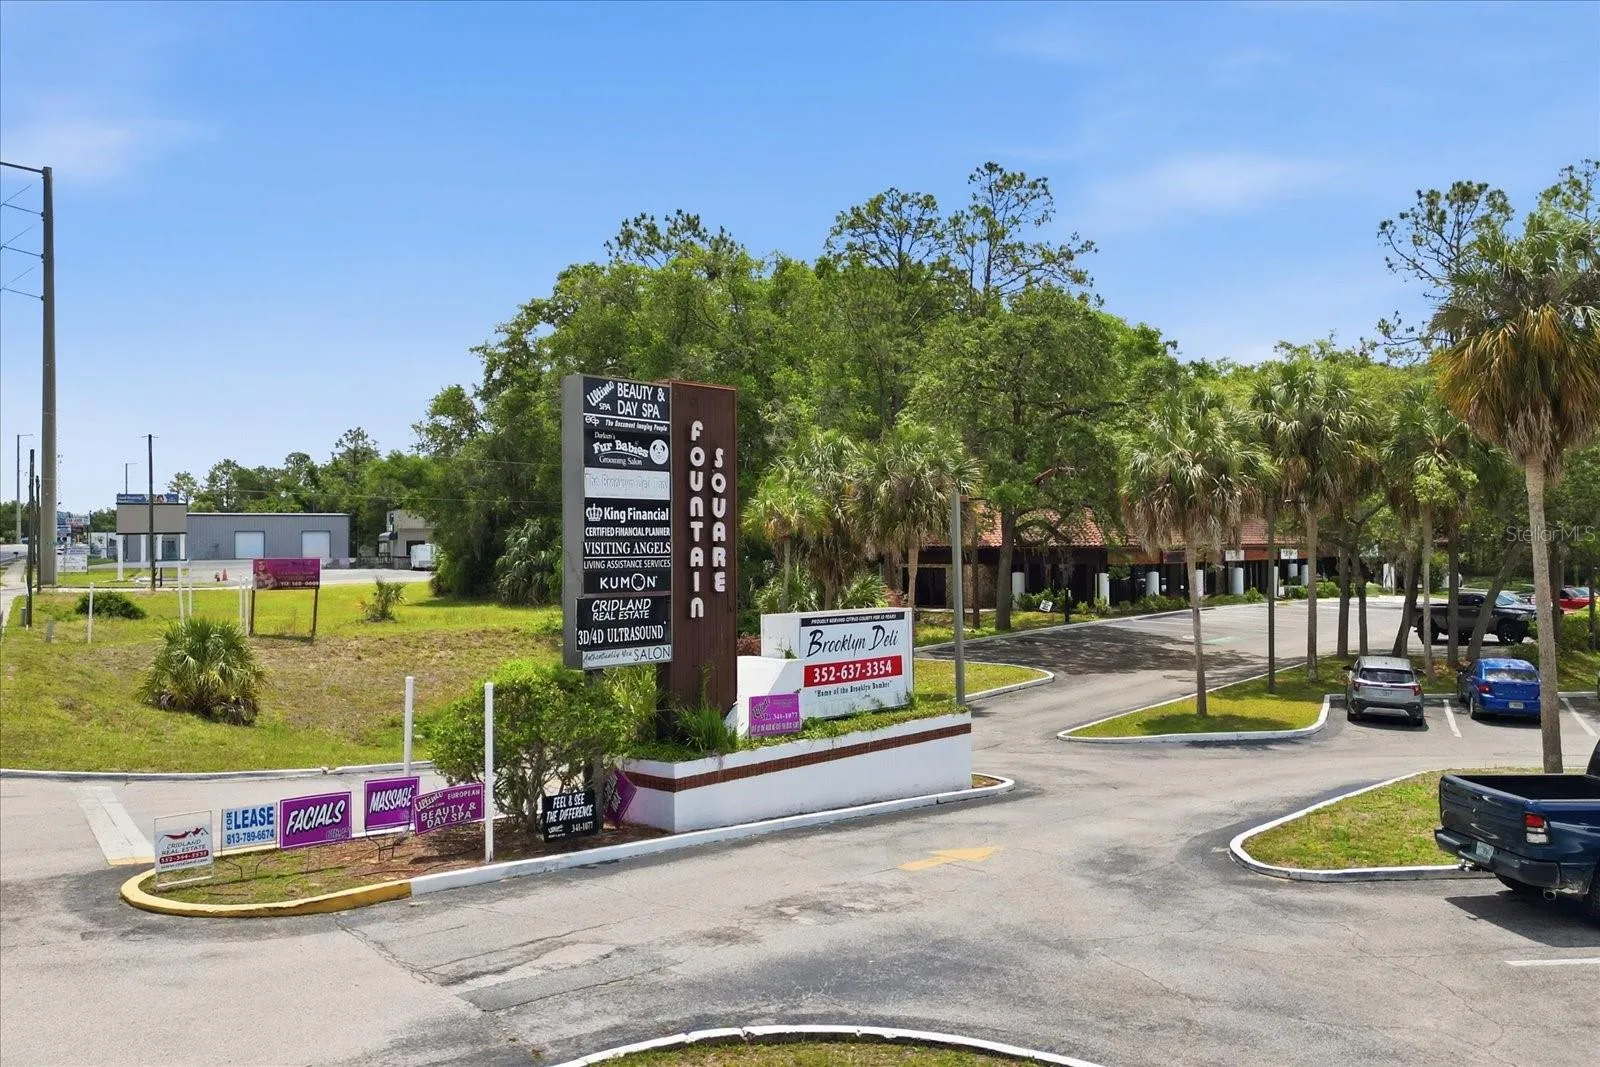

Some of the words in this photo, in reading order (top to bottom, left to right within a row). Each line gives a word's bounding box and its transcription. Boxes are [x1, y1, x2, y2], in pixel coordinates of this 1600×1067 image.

[617, 382, 653, 401] BEAUTY
[657, 387, 666, 402] &
[599, 402, 611, 411] SPA
[617, 400, 638, 416] DAY
[642, 402, 660, 418] SPA
[605, 419, 614, 427] The
[614, 420, 635, 429] Document
[636, 422, 652, 431] Imaging
[653, 424, 668, 432] People
[592, 442, 612, 454] Fur
[615, 440, 649, 457] Babies
[599, 455, 626, 467] Grooming
[627, 457, 642, 466] Salon
[603, 506, 626, 523] King
[627, 507, 669, 521] Financial
[689, 420, 705, 618] FOUNTAIN
[711, 447, 727, 592] SQUARE
[585, 527, 615, 537] CERTIFIED
[615, 527, 644, 537] FINANCIAL
[645, 527, 670, 536] PLANNER
[584, 541, 631, 555] VISITING
[632, 541, 671, 554] ANGELS
[584, 560, 606, 569] LIVING
[606, 560, 642, 569] ASSISTANCE
[644, 559, 671, 568] SERVICES
[600, 573, 656, 591] KUMON
[591, 598, 652, 613] CRIDLAND
[592, 611, 616, 622] REAL
[618, 609, 650, 620] ESTATE
[811, 617, 829, 625] PROUDLY
[829, 616, 845, 624] SERVING
[859, 614, 873, 622] COUNTY
[578, 628, 604, 646] 3D/4D
[607, 624, 664, 643] ULTRASOUND
[806, 629, 866, 657] Brooklyn
[868, 625, 899, 651] Deli
[633, 646, 671, 662] SALON
[813, 660, 892, 683] 352-637-3354
[840, 686, 848, 694] the
[850, 683, 871, 693] Brooklyn
[370, 785, 414, 814] MASSAGE
[447, 789, 480, 800] EUROPEAN
[553, 794, 566, 809] FEEL
[574, 792, 585, 806] SEE
[233, 806, 274, 830] LEASE
[286, 799, 346, 836] FACIALS
[421, 803, 464, 822] BEAUTY
[469, 801, 477, 811] &
[427, 813, 448, 829] DAY
[451, 811, 472, 822] SPA
[546, 809, 559, 824] THE
[559, 804, 594, 821] DIFFERENCE
[166, 839, 202, 850] CRIDLAND
[226, 829, 275, 845] 813-789-6674
[161, 848, 179, 856] REAL
[181, 844, 206, 853] ESTATE
